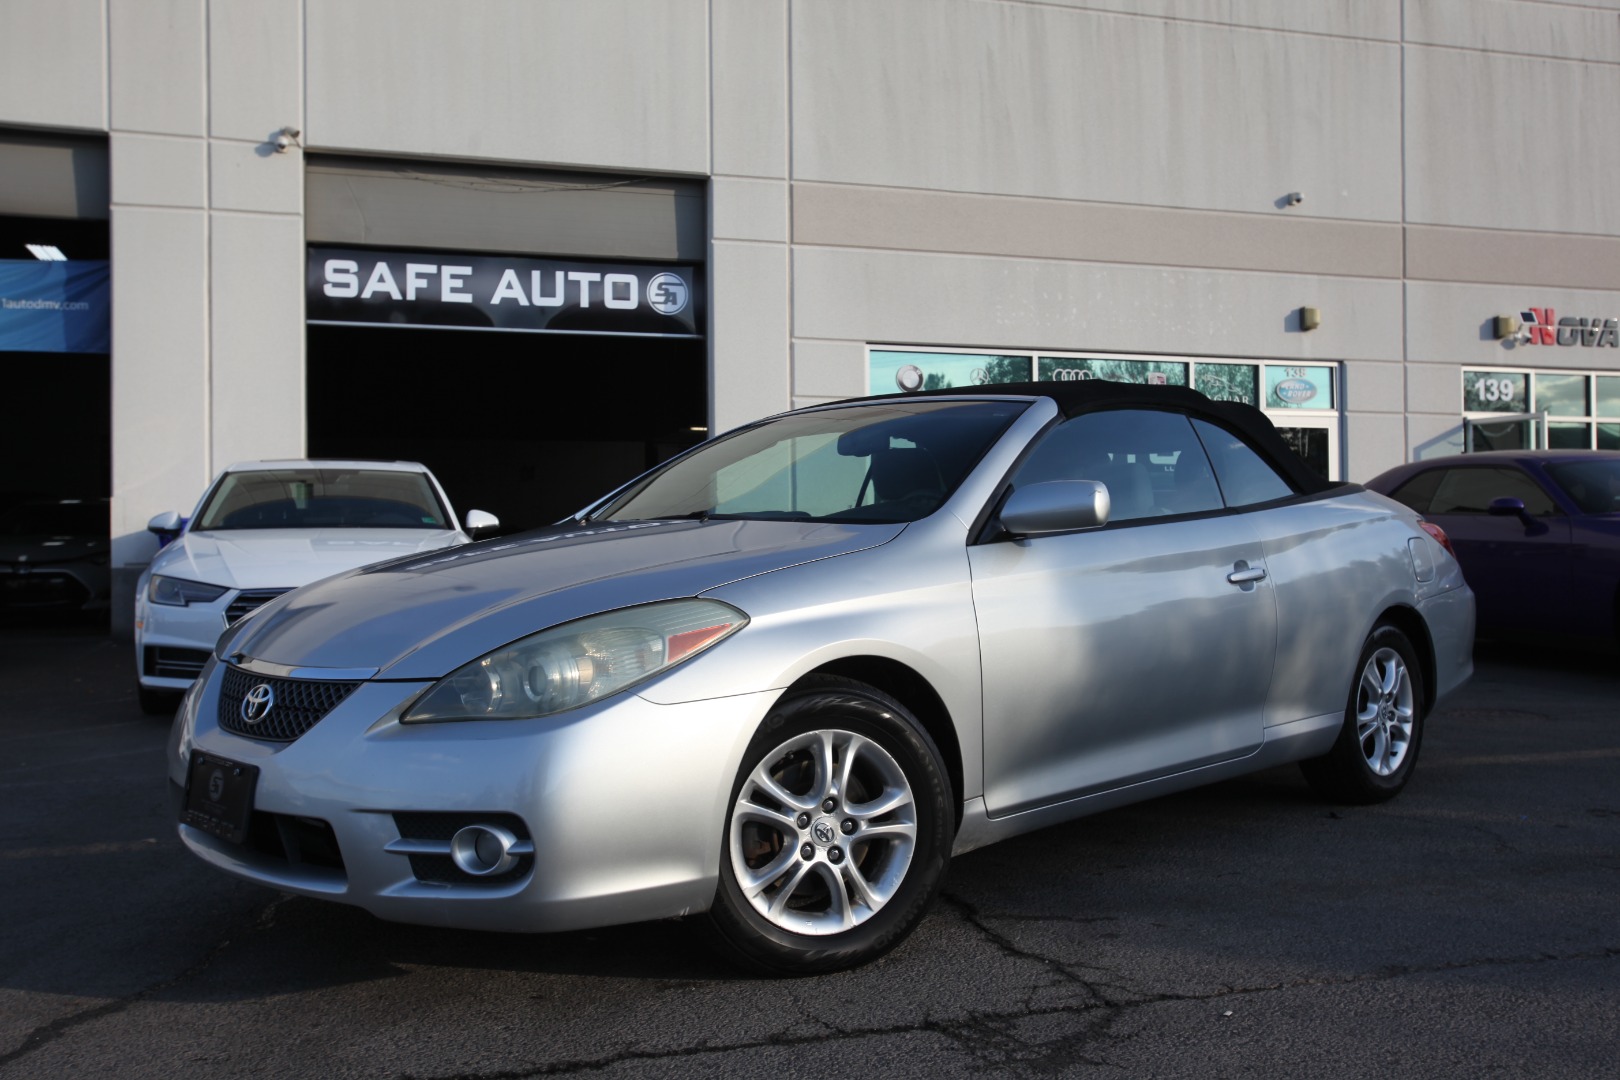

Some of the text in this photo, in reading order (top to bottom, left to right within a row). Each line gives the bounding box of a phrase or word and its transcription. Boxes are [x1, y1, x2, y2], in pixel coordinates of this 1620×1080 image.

[323, 259, 639, 310] SAFE AUTO
[1528, 308, 1619, 348] NOVA
[1206, 393, 1249, 403] GUAR
[1475, 378, 1514, 401] 139
